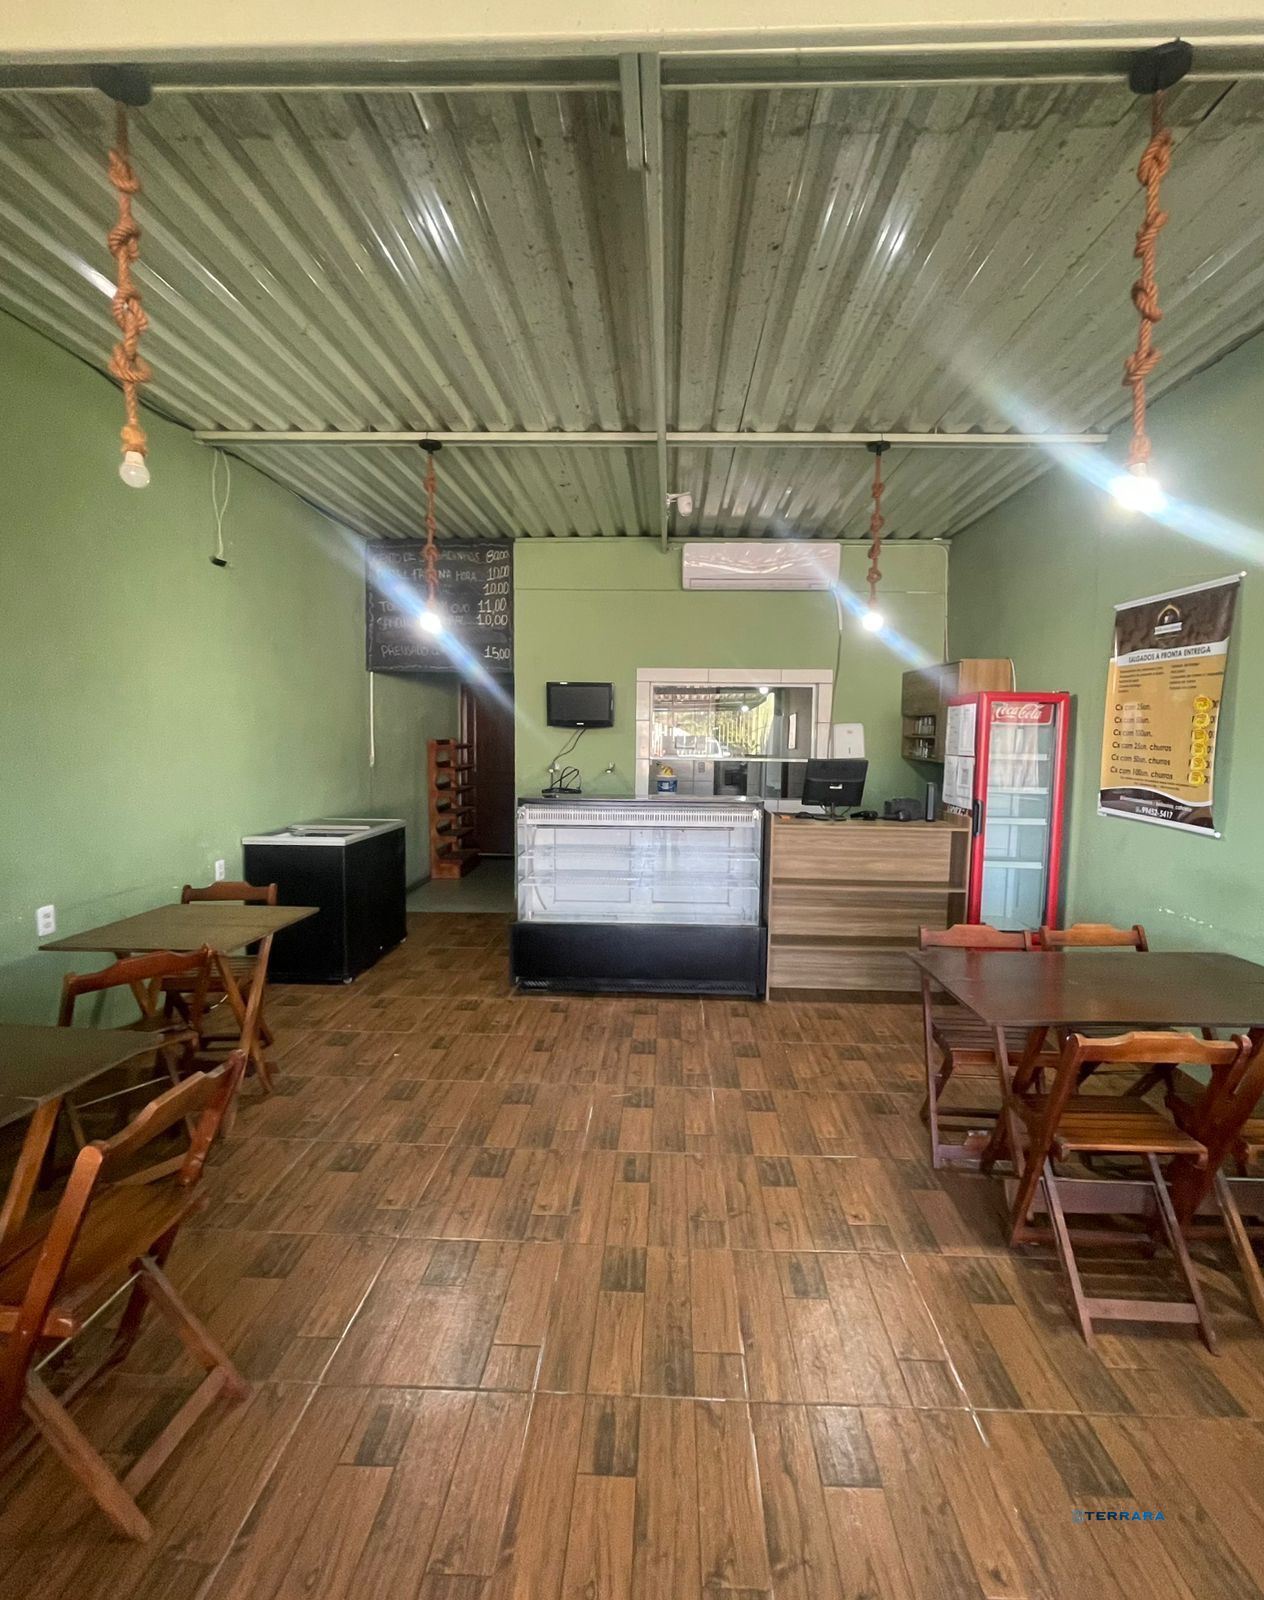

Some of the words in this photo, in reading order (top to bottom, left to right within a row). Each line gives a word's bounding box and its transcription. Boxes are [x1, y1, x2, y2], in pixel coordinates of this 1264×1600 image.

[478, 597, 507, 614] 11,00
[475, 613, 509, 627] 10,00
[1183, 645, 1212, 657] ENTREGA
